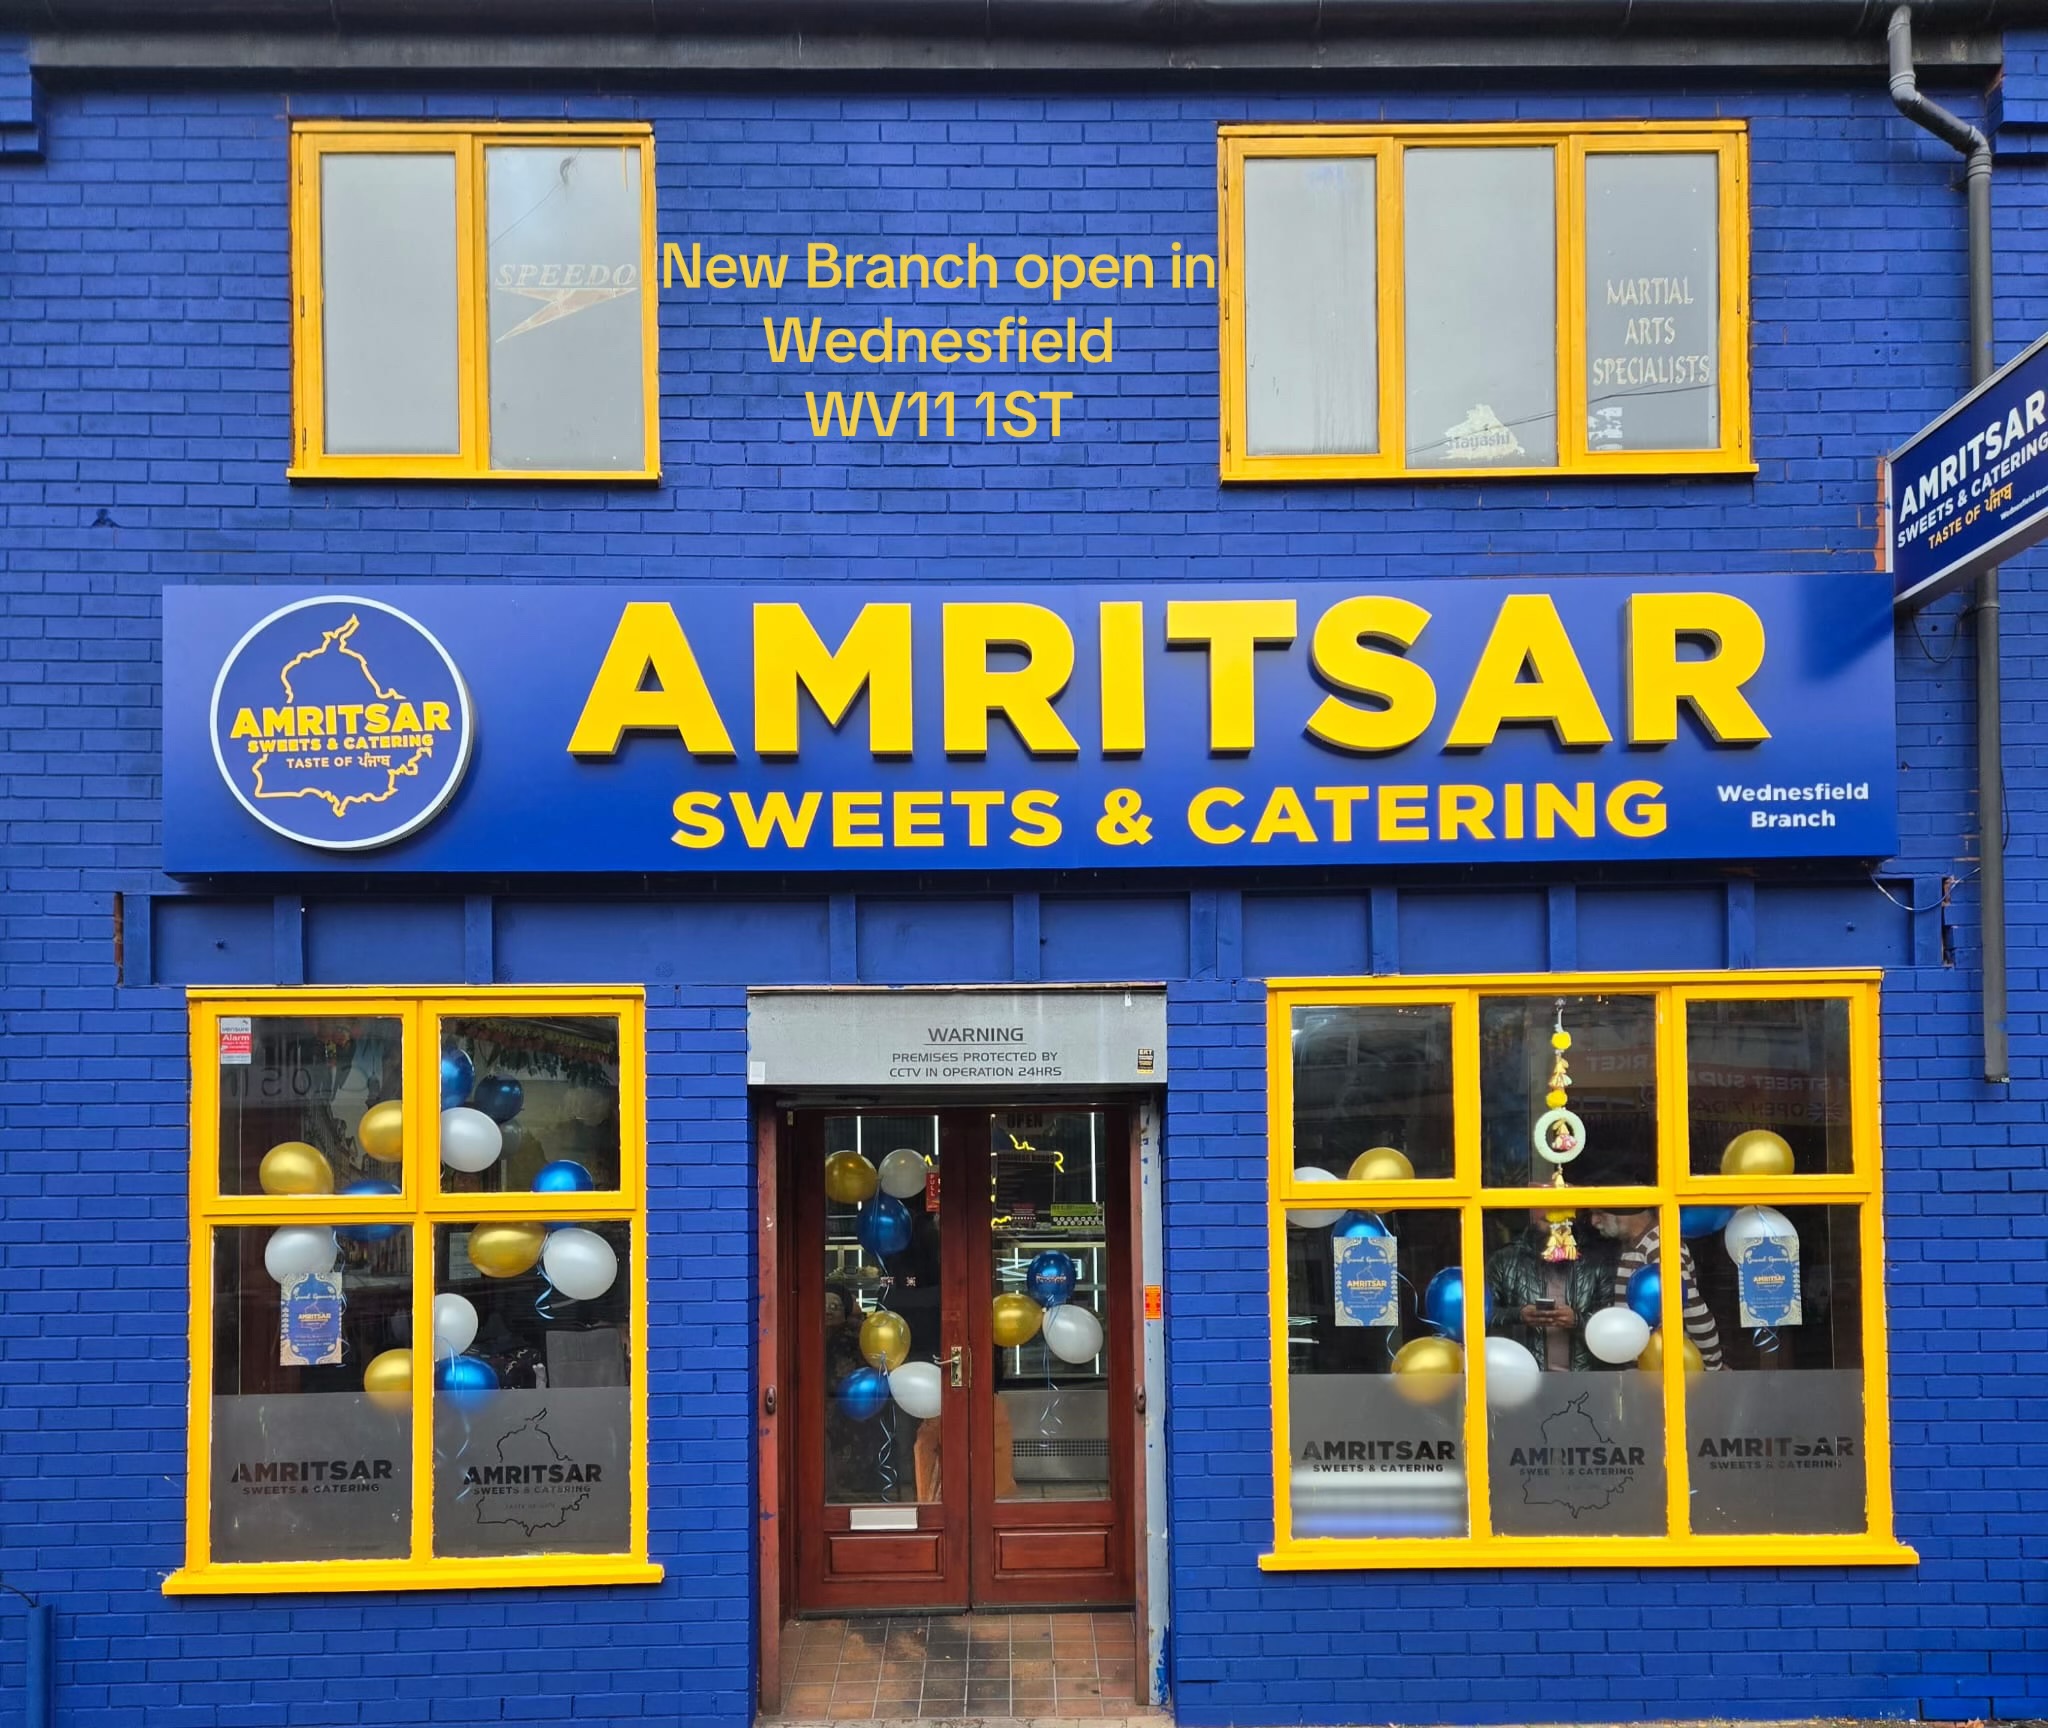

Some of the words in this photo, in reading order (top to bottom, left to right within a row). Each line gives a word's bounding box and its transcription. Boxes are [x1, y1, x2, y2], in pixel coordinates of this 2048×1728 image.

[495, 263, 637, 287] SPEEDO
[1606, 276, 1694, 306] MARTIAL
[1624, 316, 1676, 345] ARTS
[1592, 354, 1710, 386] SPECIALISTS
[1899, 389, 2047, 525] AMRITSAR
[1897, 497, 1955, 549] SWEETS
[1957, 488, 1969, 508] &
[1970, 430, 2048, 498] CATERING
[1928, 516, 1964, 550] TASTE
[1965, 504, 1981, 527] OF
[1984, 481, 2014, 513] ਪੰਜਾਬ
[565, 592, 1773, 757] AMRITSAR
[229, 700, 452, 739] AMRITSAR
[247, 737, 322, 753] SWEETS
[326, 737, 339, 751] &
[343, 733, 434, 750] CATERING
[286, 756, 330, 769] TASTE
[333, 755, 353, 768] OF
[358, 751, 392, 768] ਪੰਜਾਬ
[1716, 780, 1870, 804] Wednesfield
[670, 788, 1064, 849] SWEETS
[1095, 786, 1154, 847] &
[1187, 779, 1669, 845] CATERING
[1750, 807, 1836, 829] Branch
[222, 1033, 251, 1041] Alarm
[928, 1027, 1024, 1042] WARNING
[892, 1052, 959, 1063] PREMISES
[963, 1052, 1038, 1063] PROTECTED
[1042, 1051, 1059, 1062] BY
[889, 1067, 921, 1078] CCTV
[925, 1067, 938, 1077] IN
[942, 1066, 1014, 1077] OPERATION
[1018, 1066, 1063, 1077] 24HRS
[1347, 1279, 1388, 1288] AMRITSAR
[1301, 1440, 1456, 1461] AMRITSAR
[1509, 1446, 1646, 1467] AMRITSAR
[1697, 1436, 1855, 1458] AMRITSAR
[231, 1459, 393, 1483] AMRITSAR
[463, 1463, 603, 1486] AMRITSAR
[1312, 1463, 1365, 1473] SWEETS
[1368, 1463, 1377, 1473] &
[1379, 1463, 1444, 1473] CATERING
[1567, 1467, 1576, 1476] &
[1578, 1466, 1635, 1476] CATERING
[1709, 1460, 1762, 1470] SWEETS
[242, 1484, 298, 1496] SWEETS
[301, 1484, 309, 1494] &
[313, 1483, 381, 1494] CATERING
[473, 1485, 521, 1496] SWEETS
[534, 1485, 592, 1494] CATERING
